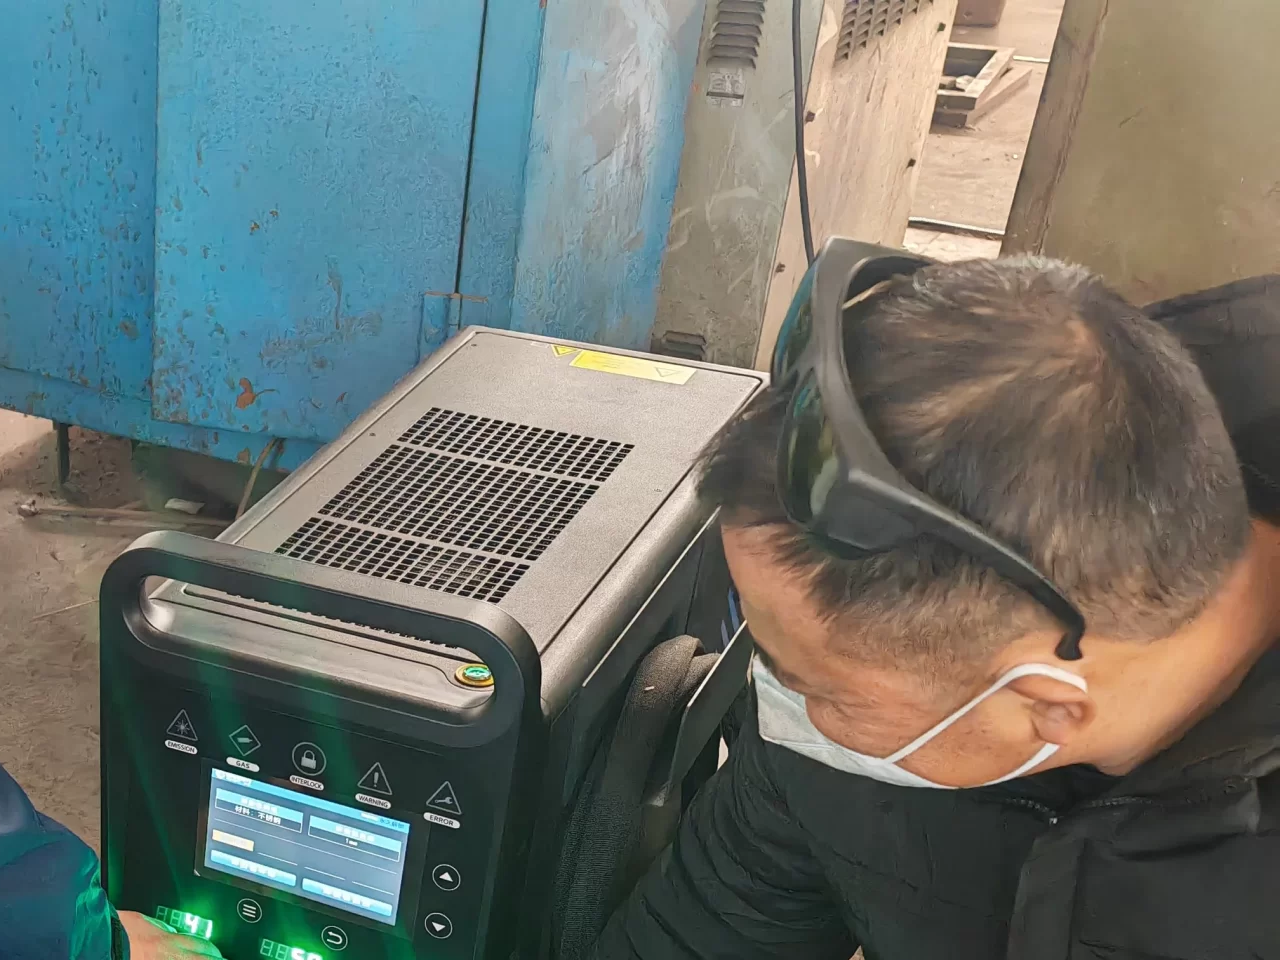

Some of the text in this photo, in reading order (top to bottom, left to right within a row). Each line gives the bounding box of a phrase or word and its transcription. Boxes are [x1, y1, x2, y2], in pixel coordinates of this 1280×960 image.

[167, 741, 195, 753] EMISSION
[235, 760, 250, 769] GAS
[291, 776, 322, 789] INTERLOCK
[358, 795, 389, 809] WARNING
[429, 814, 454, 827] ERROR
